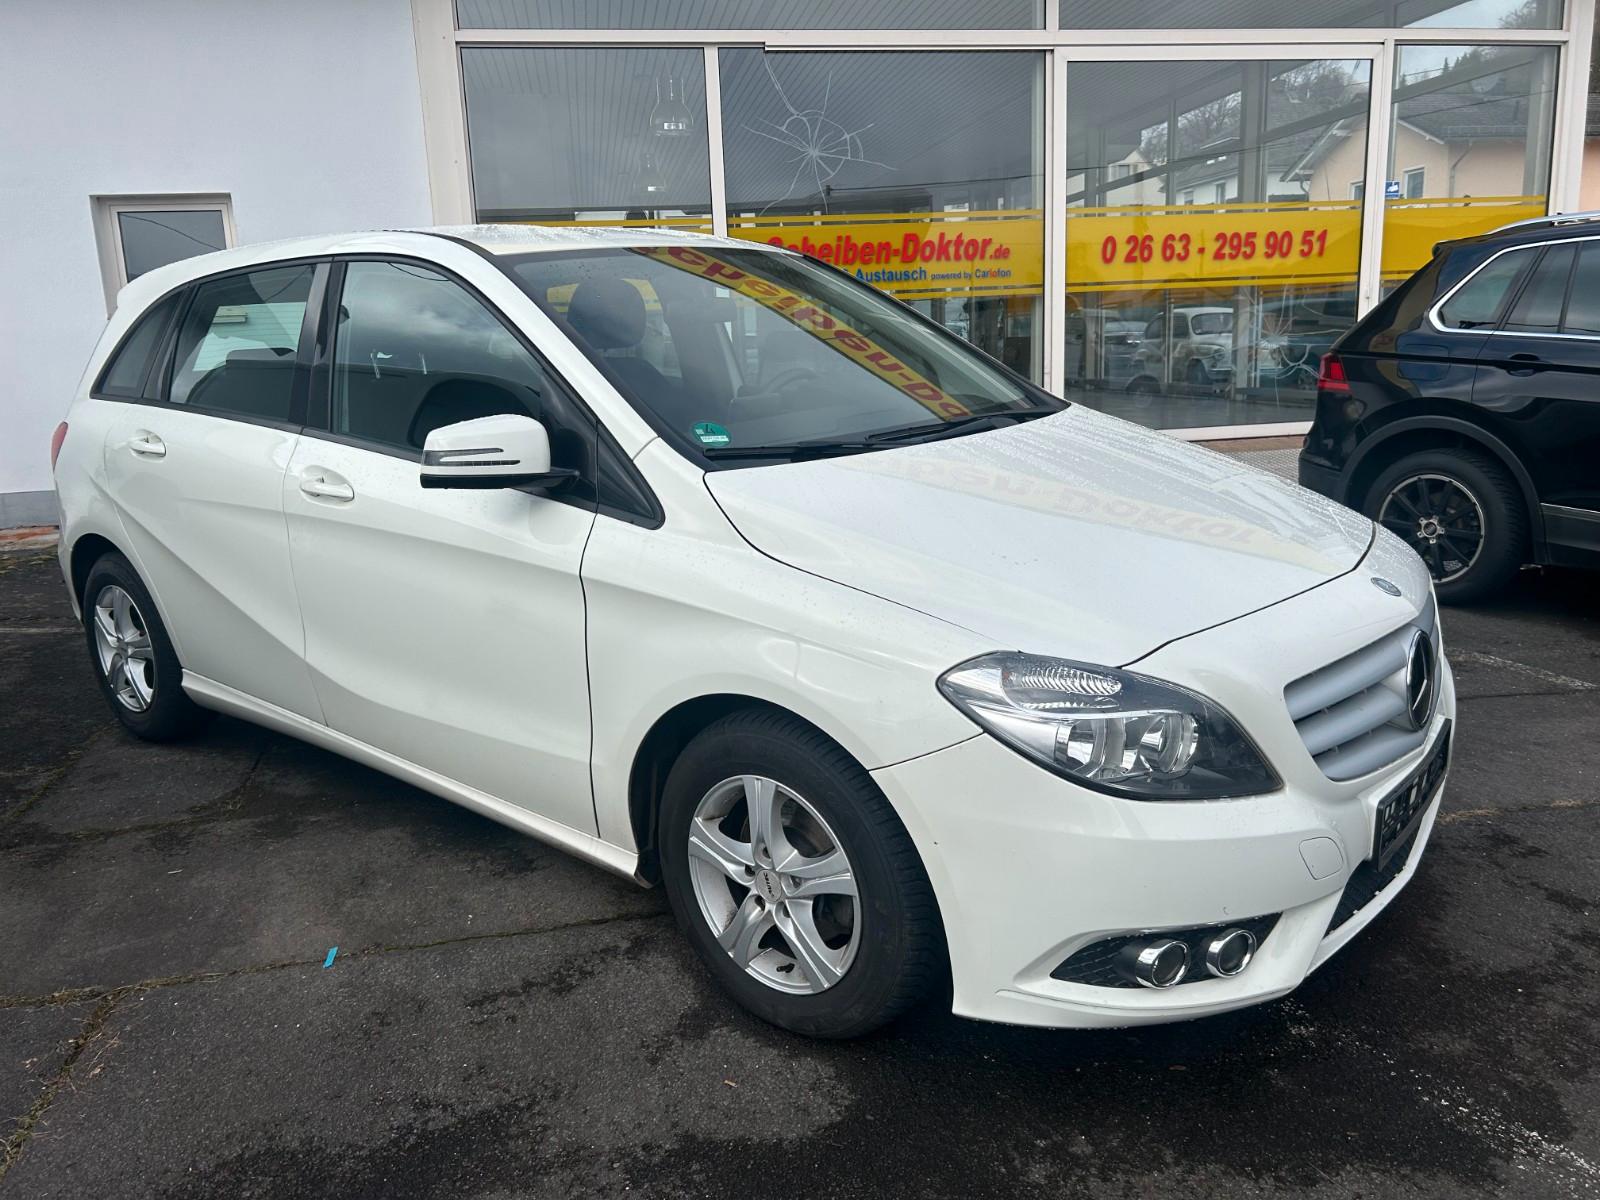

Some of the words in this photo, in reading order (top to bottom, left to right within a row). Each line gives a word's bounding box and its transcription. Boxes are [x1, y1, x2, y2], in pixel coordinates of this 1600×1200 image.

[1102, 235, 1116, 264] 0
[1124, 234, 1154, 263] 26
[1161, 233, 1191, 262] 63
[1213, 231, 1257, 260] 295
[1264, 230, 1293, 259] 90
[1300, 229, 1327, 257] 51
[856, 267, 926, 282] Austausch
[931, 269, 961, 280] powered
[964, 270, 972, 280] by
